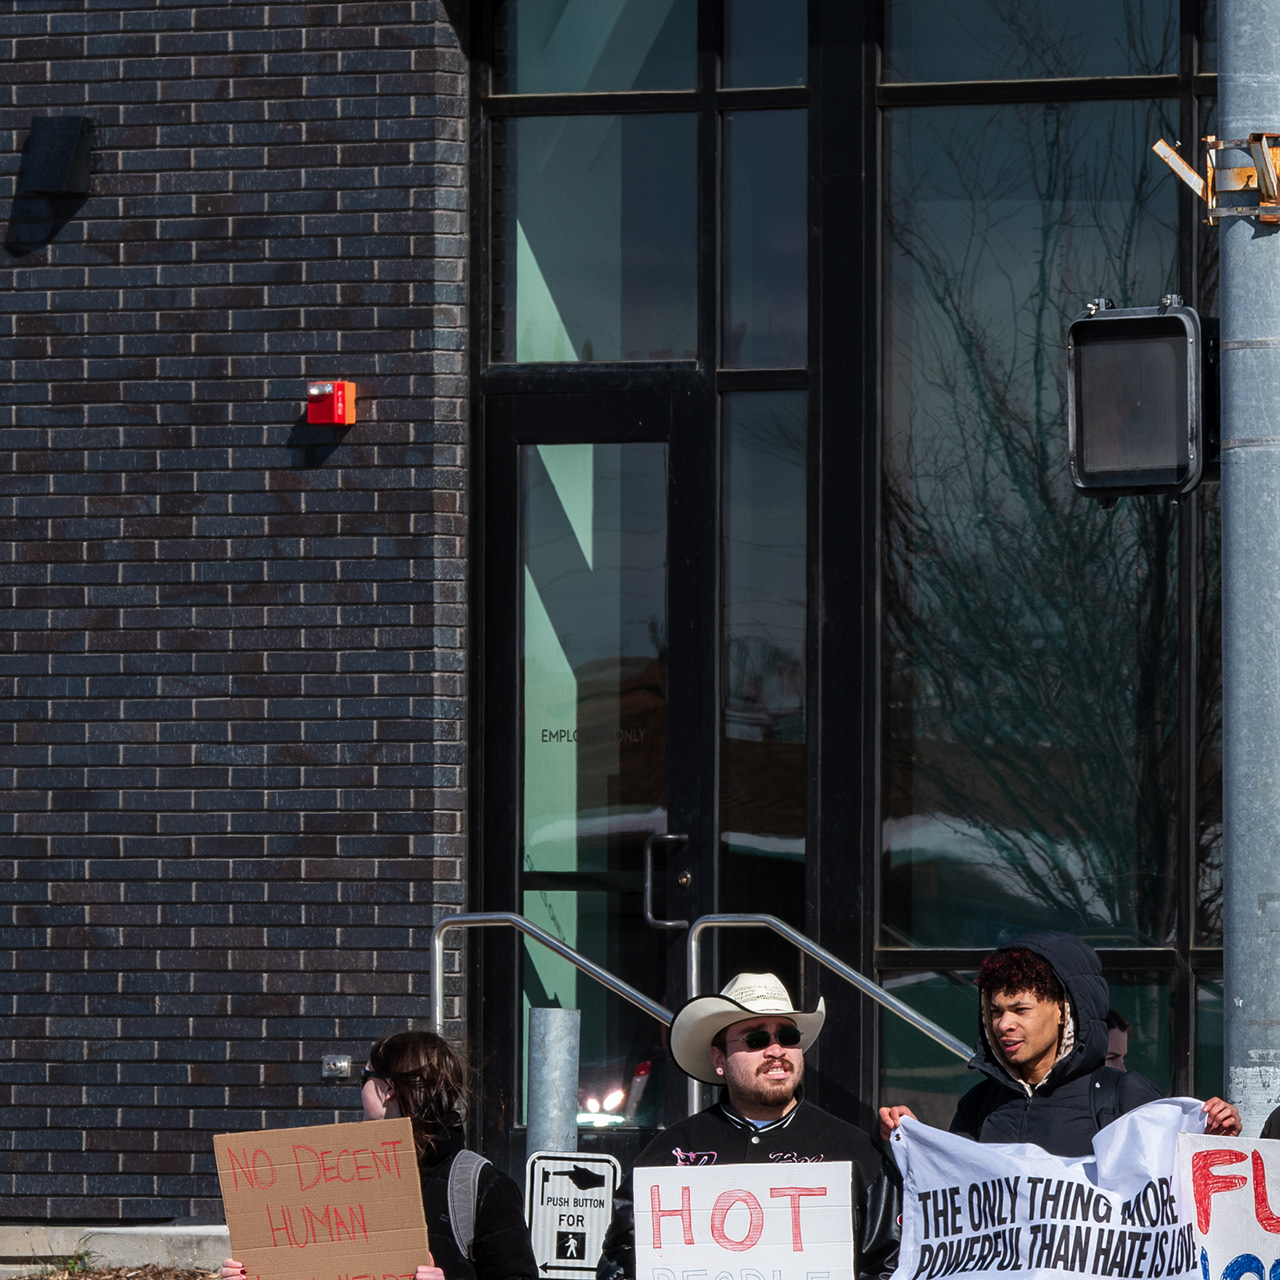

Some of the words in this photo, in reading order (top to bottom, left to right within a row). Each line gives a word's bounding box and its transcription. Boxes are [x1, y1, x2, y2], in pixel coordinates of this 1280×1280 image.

[541, 728, 578, 744] EMPLO
[227, 1147, 275, 1192] NO
[293, 1140, 403, 1192] DECENT
[266, 1203, 369, 1248] HUMAN
[546, 1197, 570, 1207] PUSH
[573, 1198, 605, 1209] BUTTON
[558, 1214, 585, 1227] FOR
[650, 1185, 828, 1252] HOT
[918, 1186, 963, 1240] THE
[967, 1175, 1021, 1233] ONLY
[1027, 1176, 1112, 1224] THING
[1120, 1175, 1179, 1228] MORE
[1027, 1223, 1091, 1274] THAN
[1092, 1228, 1151, 1279] HATE
[1147, 1230, 1169, 1279] IS
[1166, 1221, 1198, 1277] LOVE
